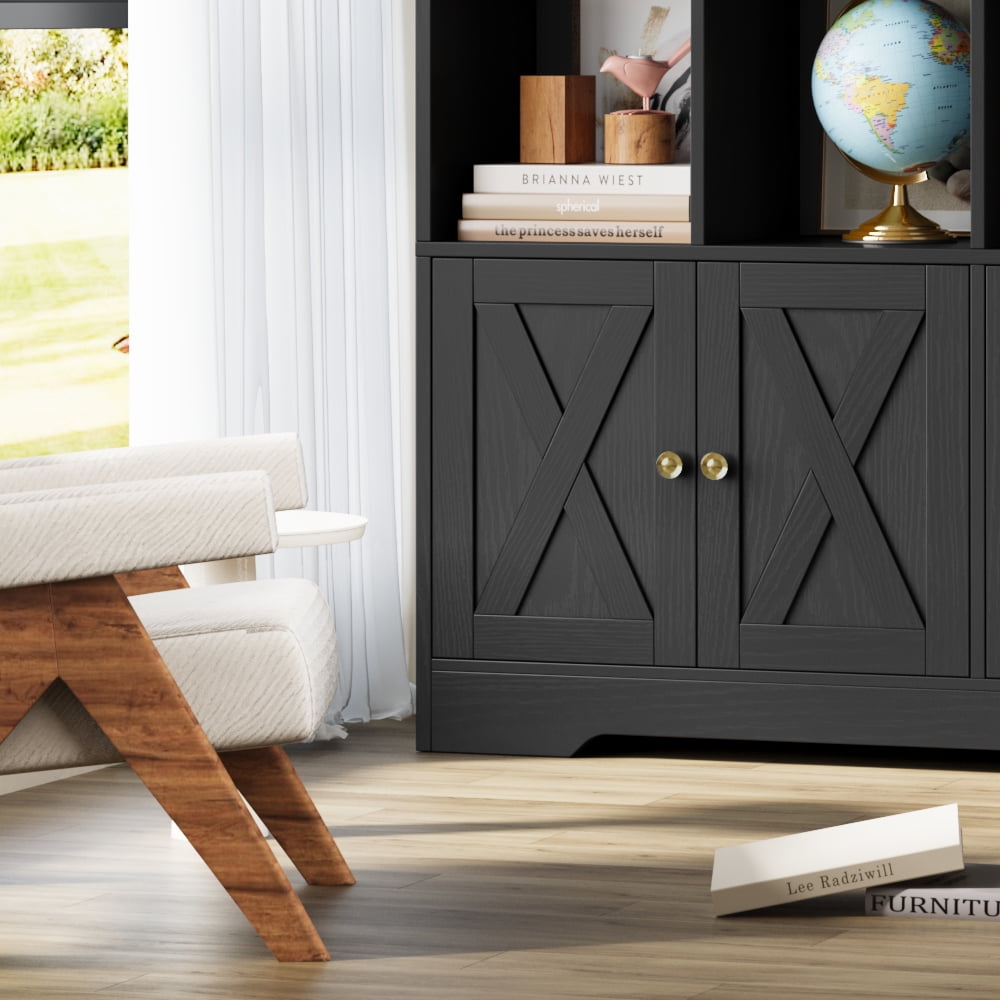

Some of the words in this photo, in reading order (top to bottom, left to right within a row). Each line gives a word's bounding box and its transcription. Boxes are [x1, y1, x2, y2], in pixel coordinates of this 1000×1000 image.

[522, 174, 591, 186] BRIANNA
[598, 175, 645, 186] WIEST
[555, 199, 600, 215] spherical
[786, 881, 814, 896] Lee
[819, 862, 895, 889] Radziwill
